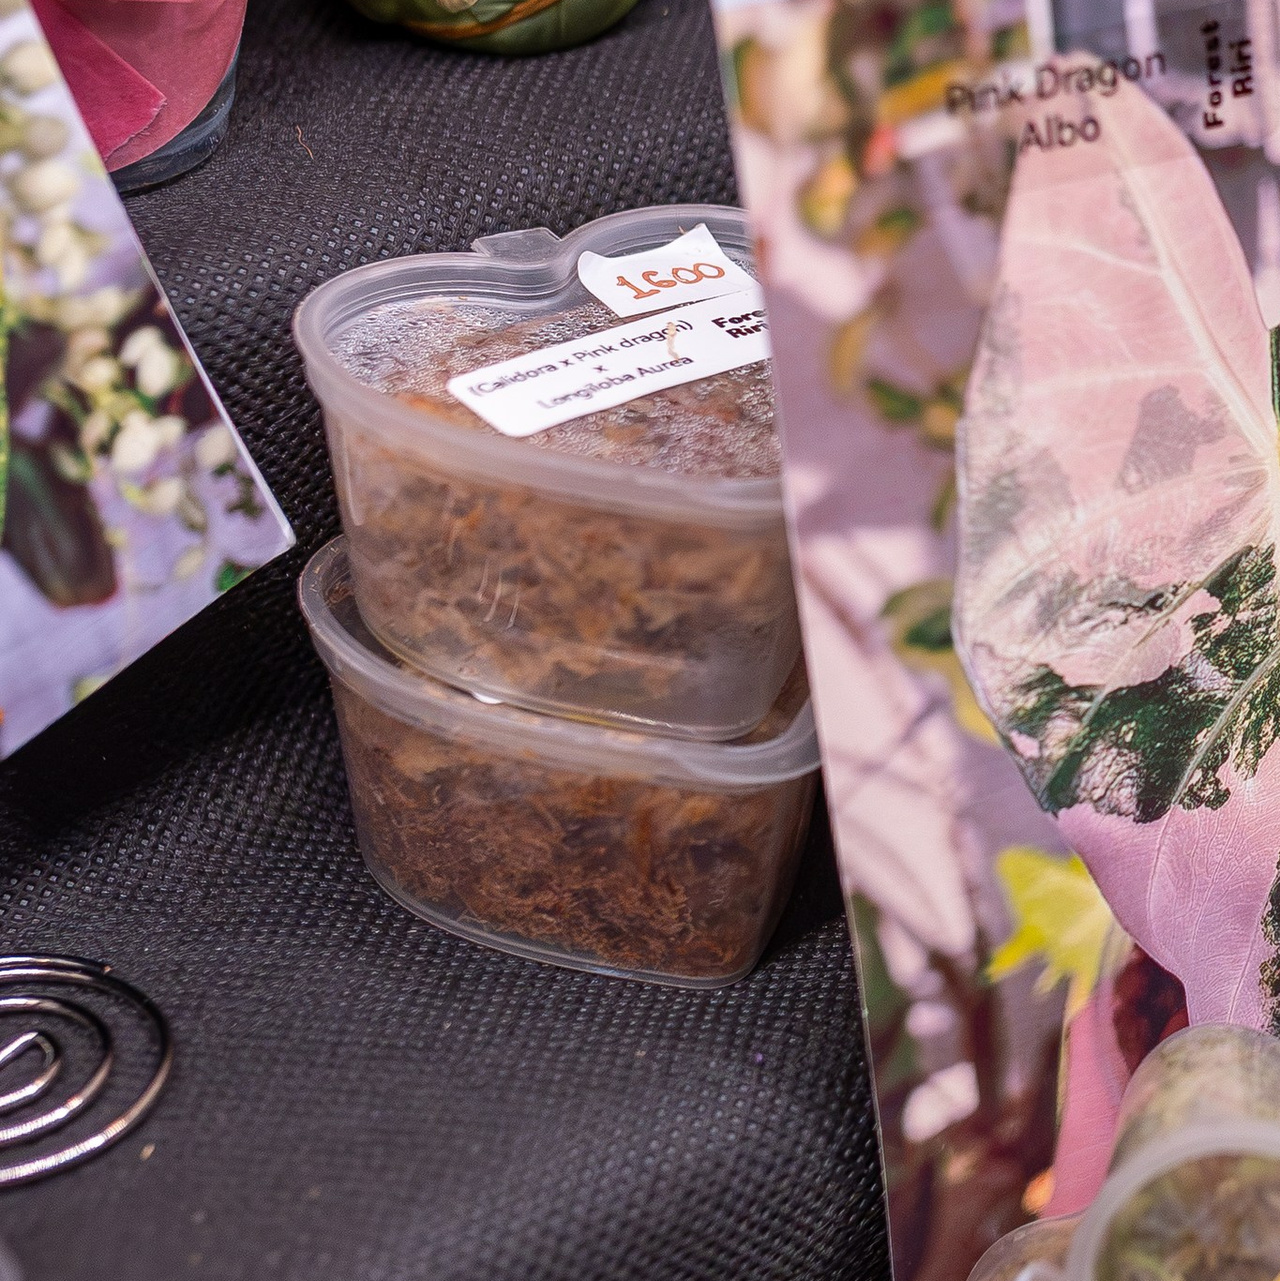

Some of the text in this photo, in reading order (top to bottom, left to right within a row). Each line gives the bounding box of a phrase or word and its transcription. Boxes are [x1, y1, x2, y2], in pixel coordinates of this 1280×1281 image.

[1035, 52, 1167, 97] Dragon
[1201, 20, 1224, 130] Forest
[1020, 112, 1101, 153] Albo
[616, 262, 726, 300] 1600
[711, 308, 768, 328] Fore
[572, 342, 621, 363] Pink
[636, 356, 694, 379] Aurea
